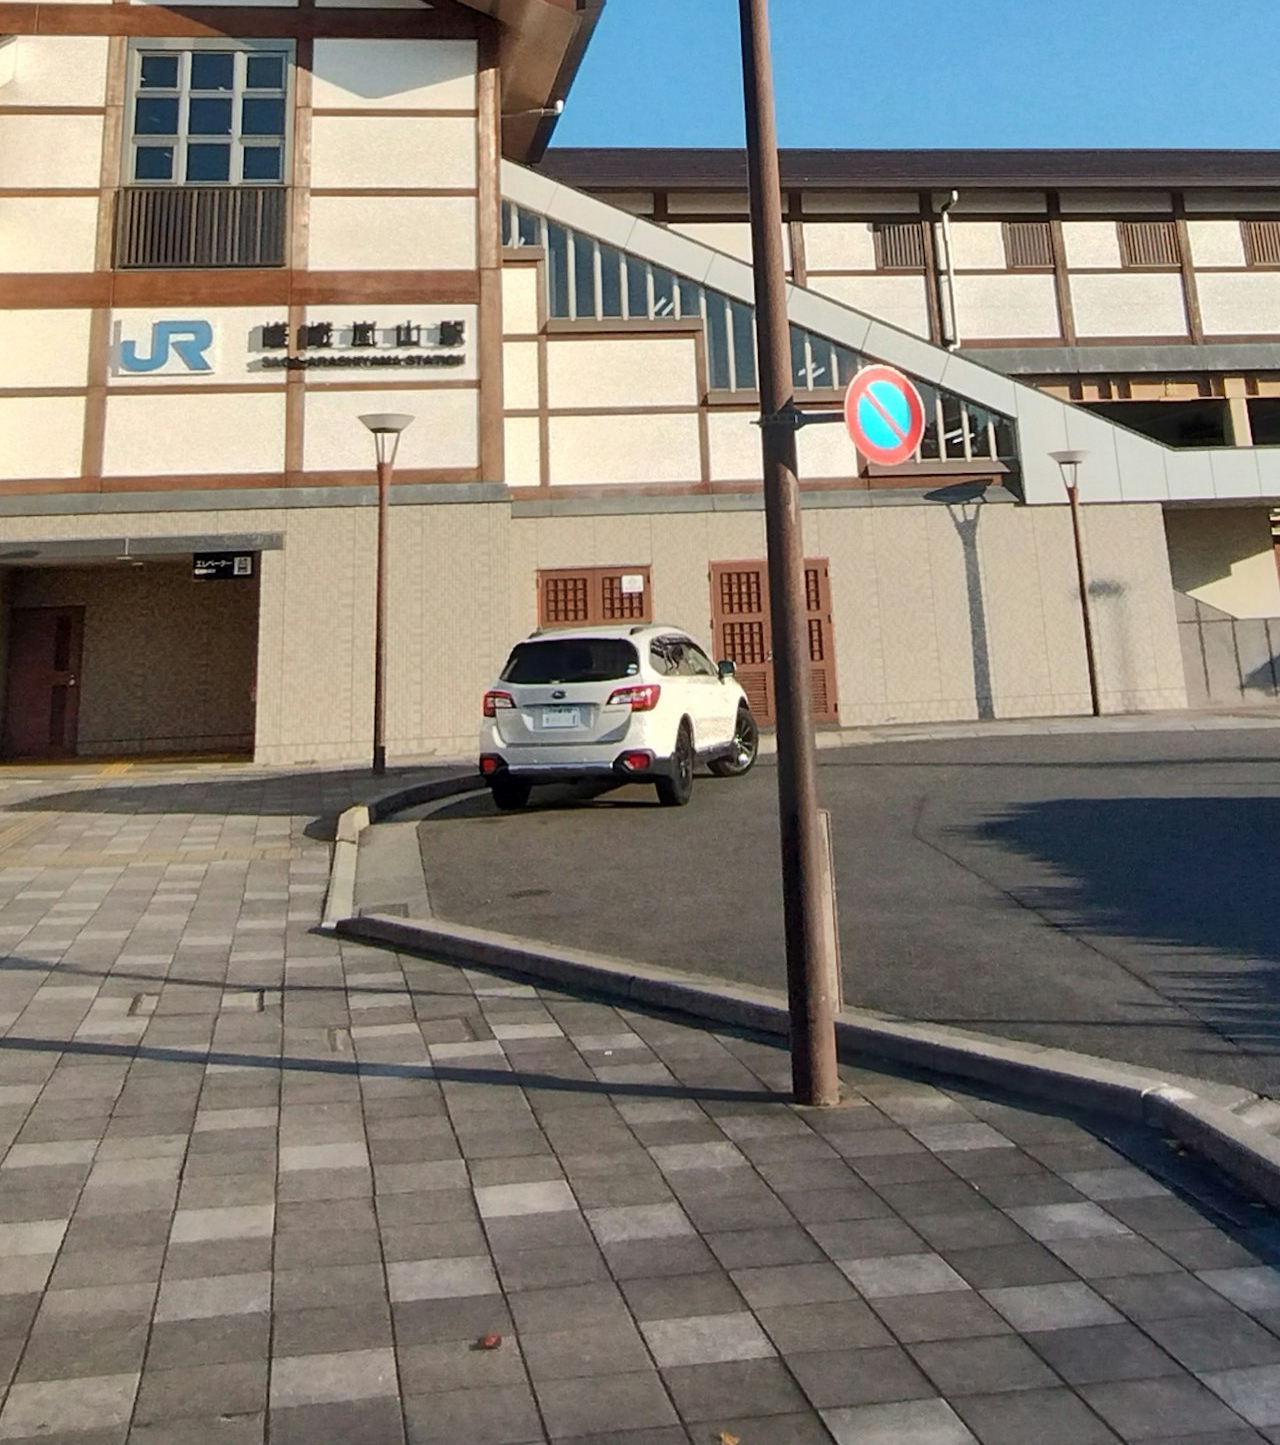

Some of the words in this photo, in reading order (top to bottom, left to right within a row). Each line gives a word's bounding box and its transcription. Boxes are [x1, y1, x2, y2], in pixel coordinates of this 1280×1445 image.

[120, 320, 213, 371] JR
[195, 560, 233, 568] エレベーター
